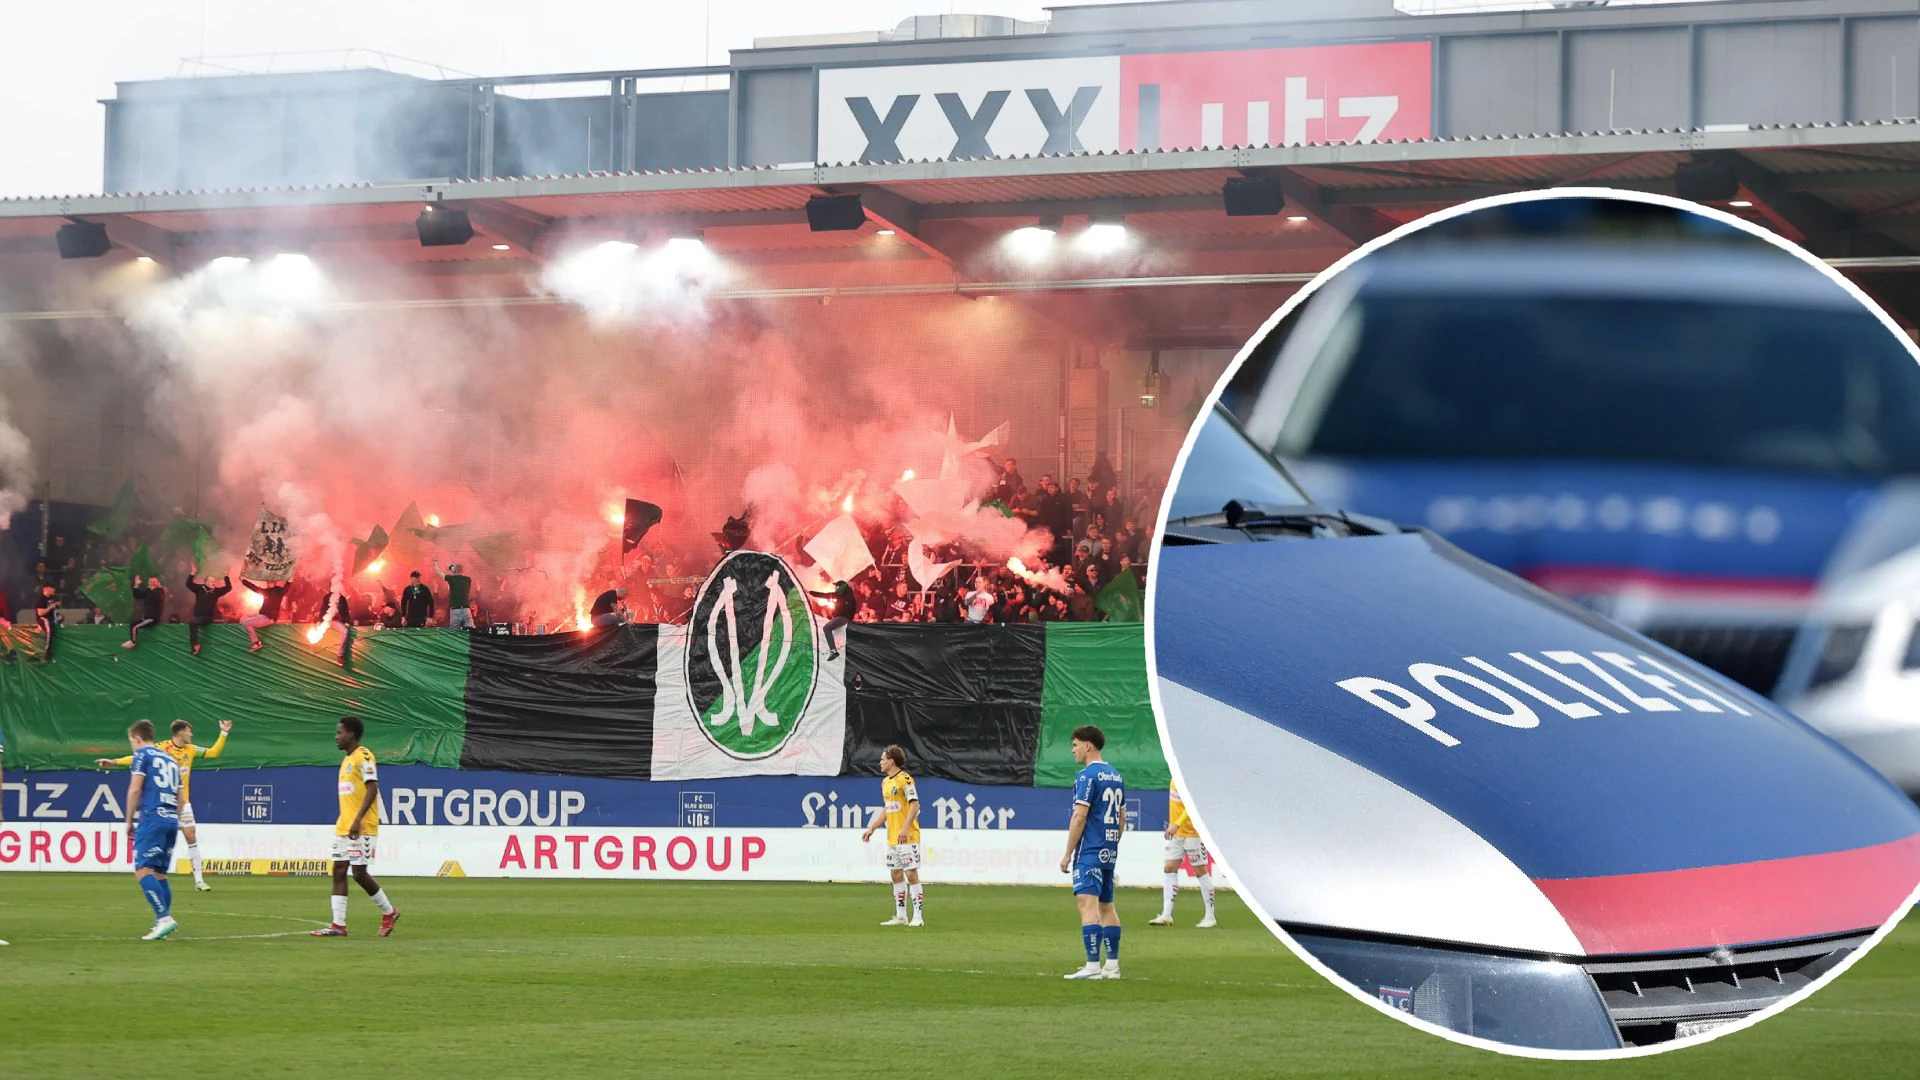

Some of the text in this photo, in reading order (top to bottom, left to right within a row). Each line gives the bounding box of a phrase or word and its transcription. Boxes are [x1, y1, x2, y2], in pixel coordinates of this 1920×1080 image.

[1335, 650, 1752, 748] POLIZEI
[152, 757, 179, 794] 30
[377, 788, 586, 826] ARTGROUP
[932, 793, 1016, 830] Bier
[1102, 787, 1123, 824] 29
[499, 834, 767, 872] ARTGROUP
